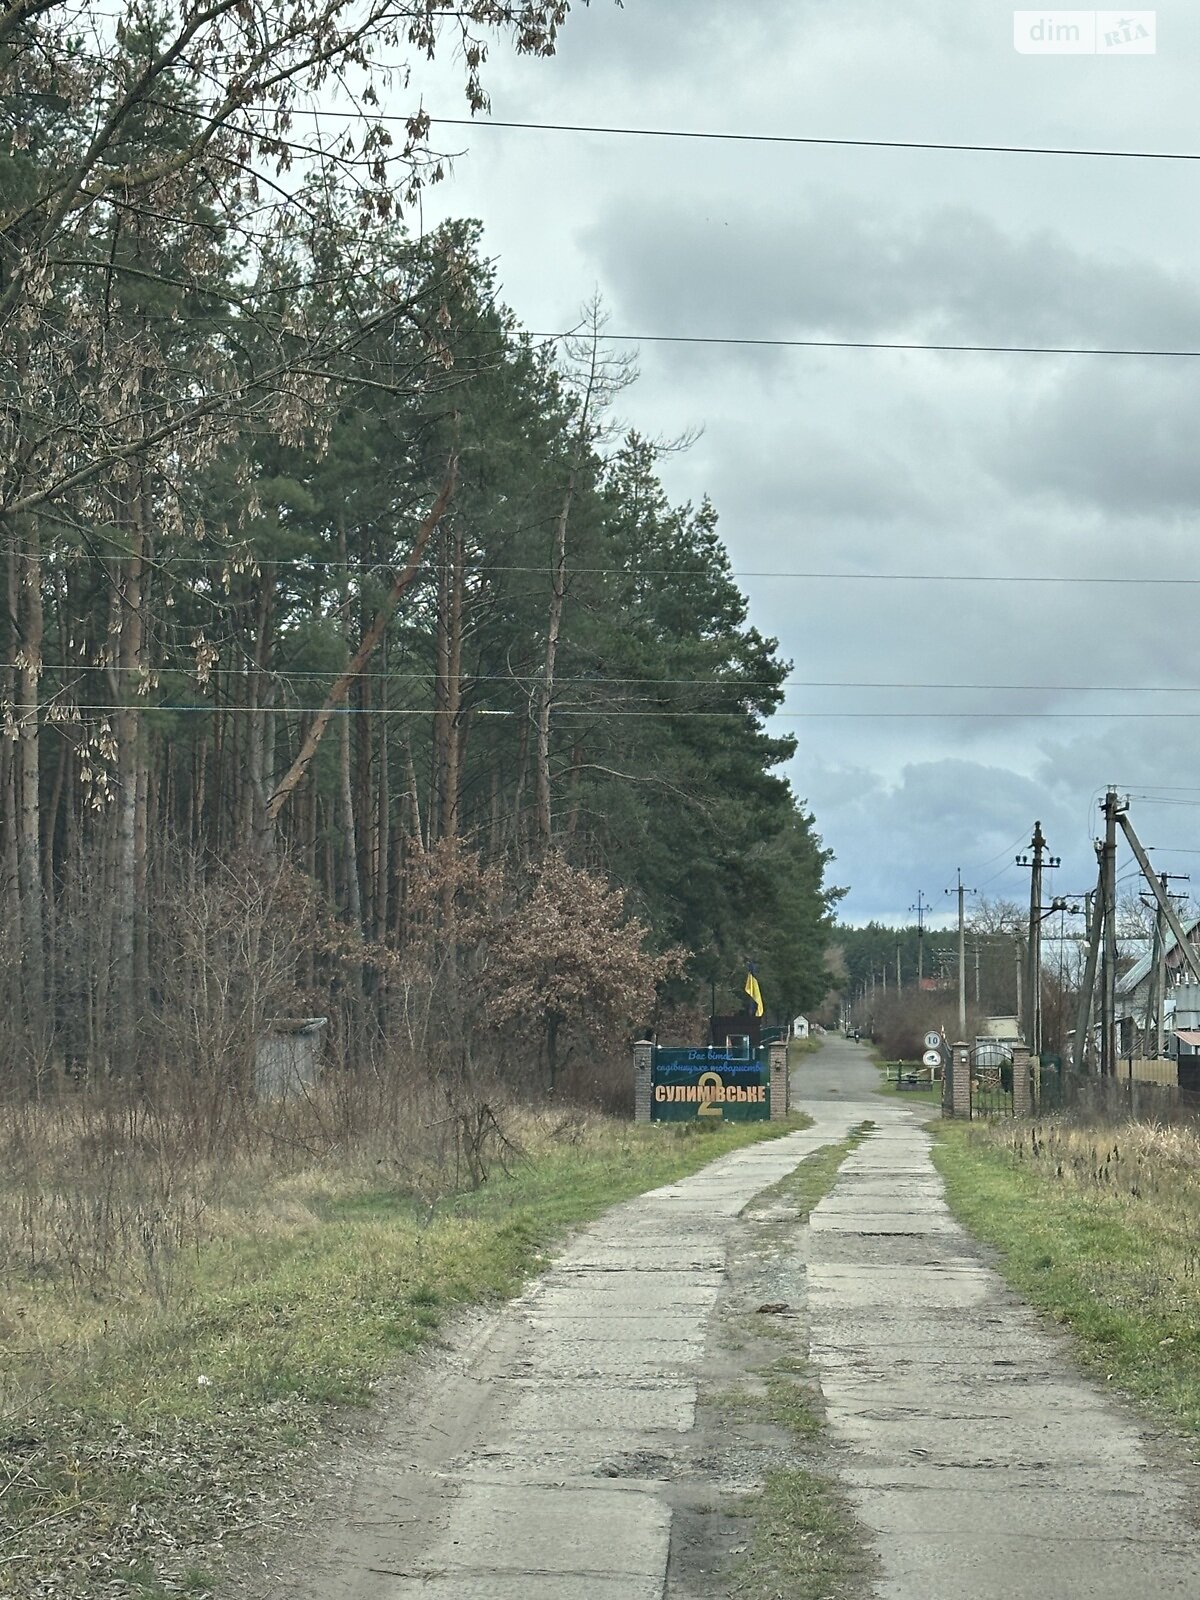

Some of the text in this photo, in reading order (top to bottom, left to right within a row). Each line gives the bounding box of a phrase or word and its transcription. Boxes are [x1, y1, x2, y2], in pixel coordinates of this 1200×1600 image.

[928, 1036, 938, 1045] 10
[655, 1086, 766, 1102] СУЛИМІВСЬКЕ
[697, 1071, 723, 1116] 2
